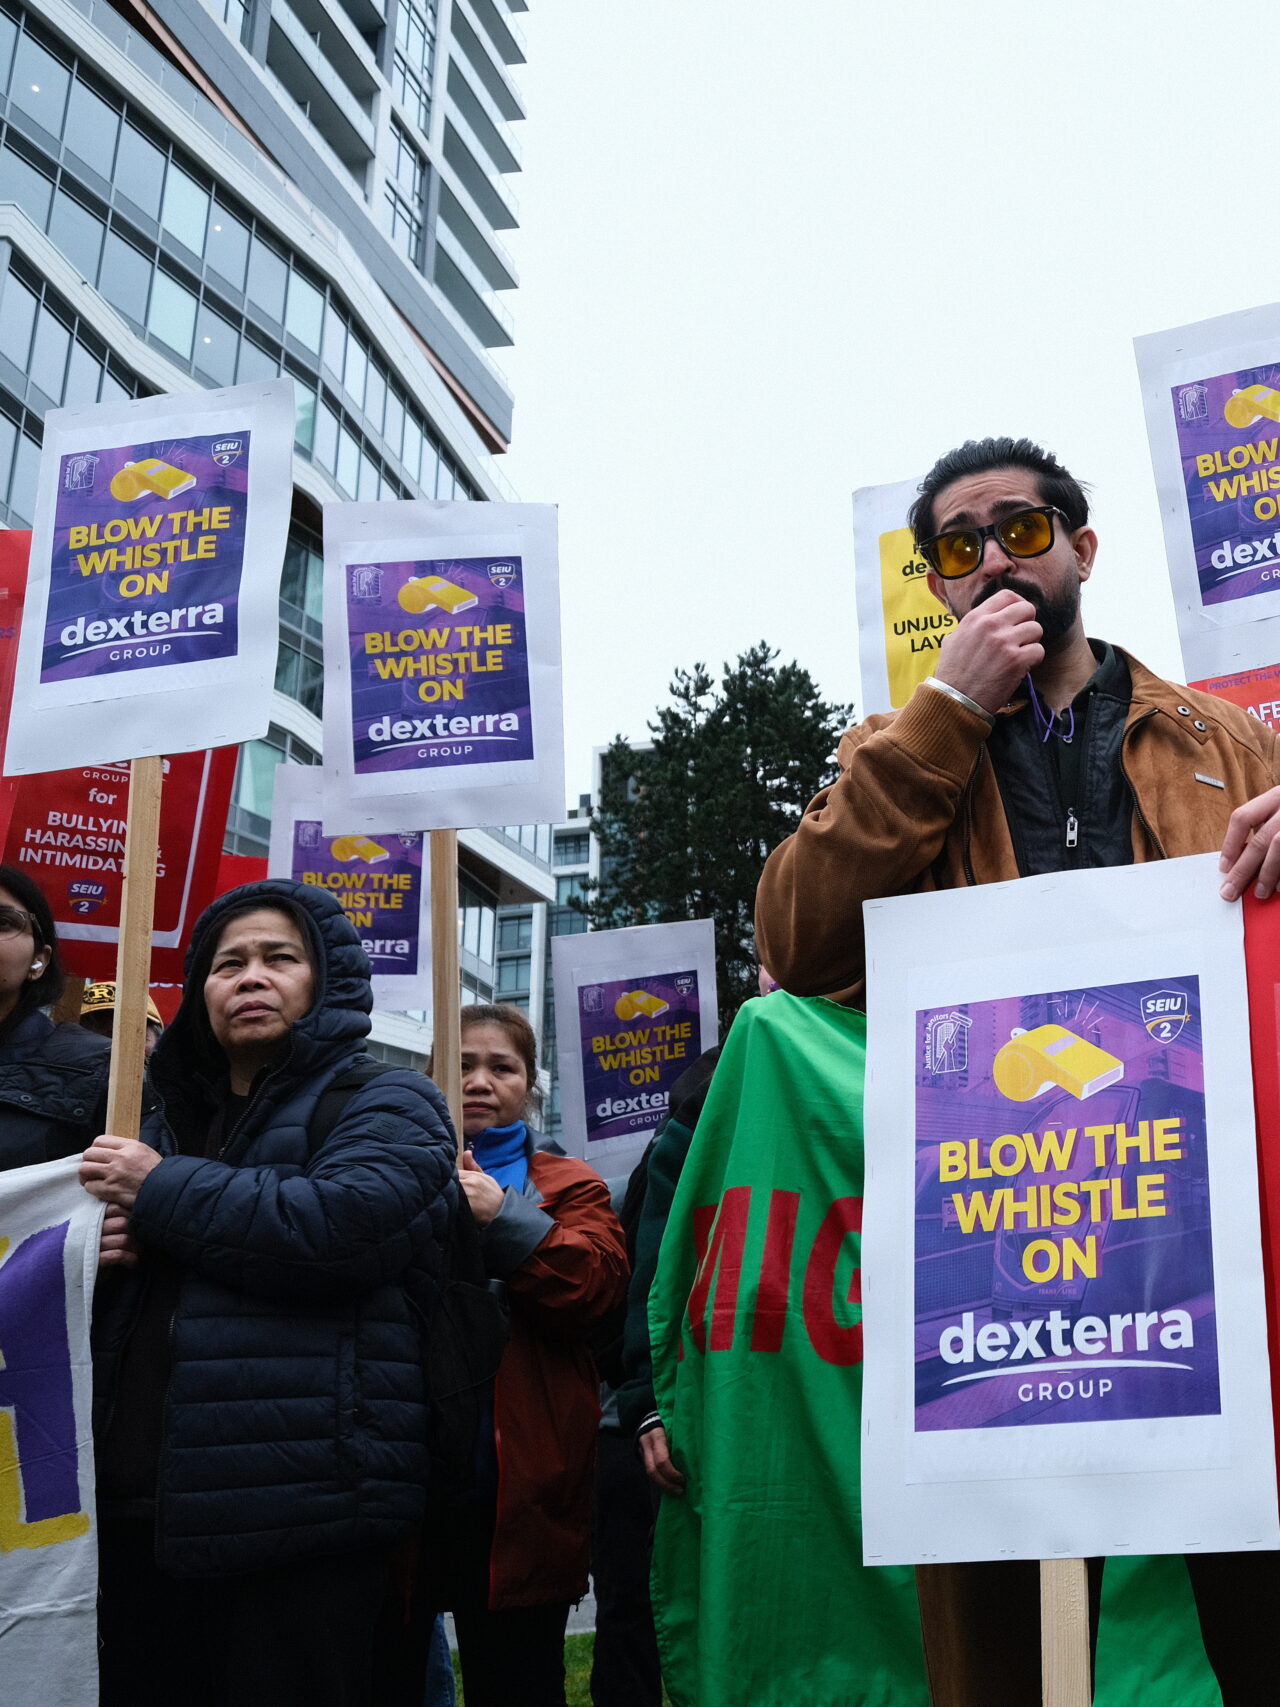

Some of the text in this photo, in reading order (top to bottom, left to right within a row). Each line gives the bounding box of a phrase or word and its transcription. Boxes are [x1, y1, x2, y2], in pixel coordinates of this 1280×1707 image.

[214, 440, 238, 452] SEIU
[1196, 437, 1278, 478] BLOW
[220, 455, 230, 465] 2
[69, 506, 231, 550] BLOW THE
[76, 535, 216, 577] WHISTLE
[491, 565, 512, 575] SEIU
[498, 577, 506, 586] 2
[119, 571, 169, 598] ON
[60, 602, 224, 647] dexterra
[893, 613, 960, 636] UNJUS
[364, 623, 512, 654] BLOW THE
[910, 632, 952, 653] LAY
[109, 643, 172, 661] GROUP
[374, 650, 503, 679] WHISTLE
[418, 681, 464, 702] ON
[1208, 672, 1273, 691] PROTECT THE
[367, 712, 519, 742] dexterra
[417, 745, 473, 758] GROUP
[82, 770, 129, 783] GROUP
[88, 787, 118, 805] for
[47, 811, 128, 834] BULLYIN
[24, 829, 126, 854] HARASSIN
[18, 846, 167, 878] INTIMIDATG
[71, 883, 103, 896] SEIU
[302, 871, 412, 890] BLOW THE
[78, 899, 89, 913] 2
[332, 892, 404, 910] HISTLE
[361, 939, 410, 954] erra
[1145, 997, 1182, 1014] SEIU
[591, 1022, 692, 1054] BLOW THE
[1159, 1022, 1172, 1038] 2
[599, 1042, 686, 1071] WHISTLE
[629, 1065, 660, 1086] ON
[596, 1091, 670, 1118] dexter
[939, 1118, 1182, 1183] BLOW THE
[952, 1174, 1166, 1234] WHISTLE
[1022, 1235, 1097, 1283] ON
[939, 1308, 1194, 1364] dexterra
[1018, 1379, 1113, 1403] GROUP
